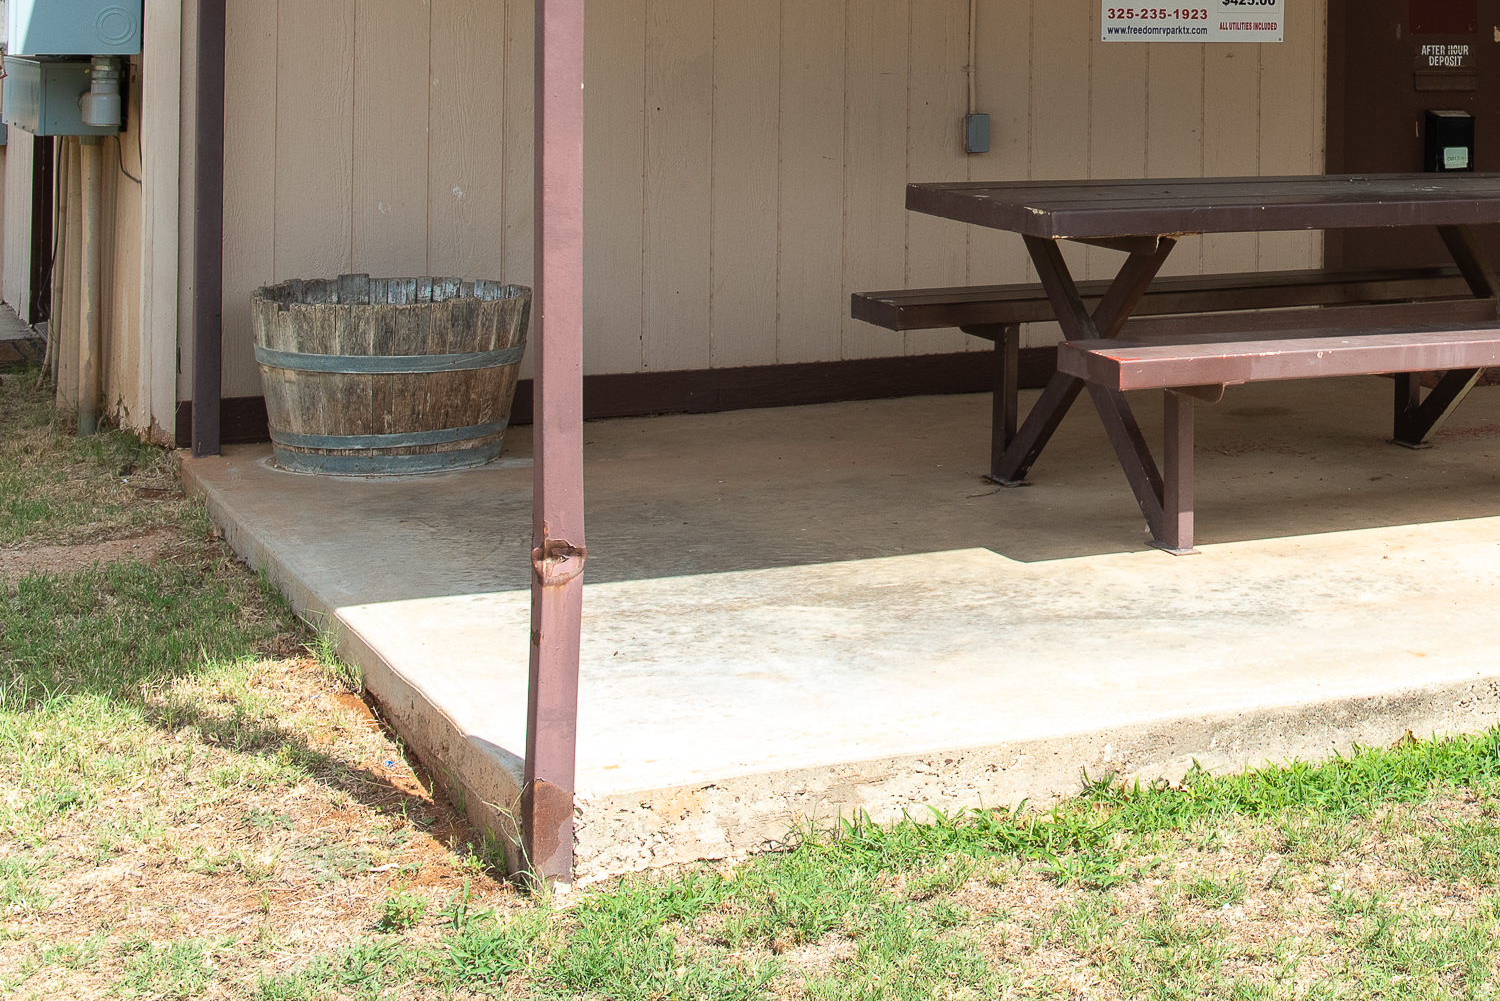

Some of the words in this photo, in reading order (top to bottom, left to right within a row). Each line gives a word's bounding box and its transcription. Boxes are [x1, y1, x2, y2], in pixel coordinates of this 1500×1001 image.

[1107, 8, 1208, 20] 325-235-1923
[1107, 25, 1208, 36] www.freedomrvparktx.com
[1219, 21, 1228, 31] ALL
[1228, 21, 1252, 31] UTILITIES
[1253, 21, 1278, 31] INCLUDED
[1421, 44, 1446, 55] AFTER
[1447, 44, 1469, 55] HOUR
[1428, 55, 1463, 66] DEPOSIT
